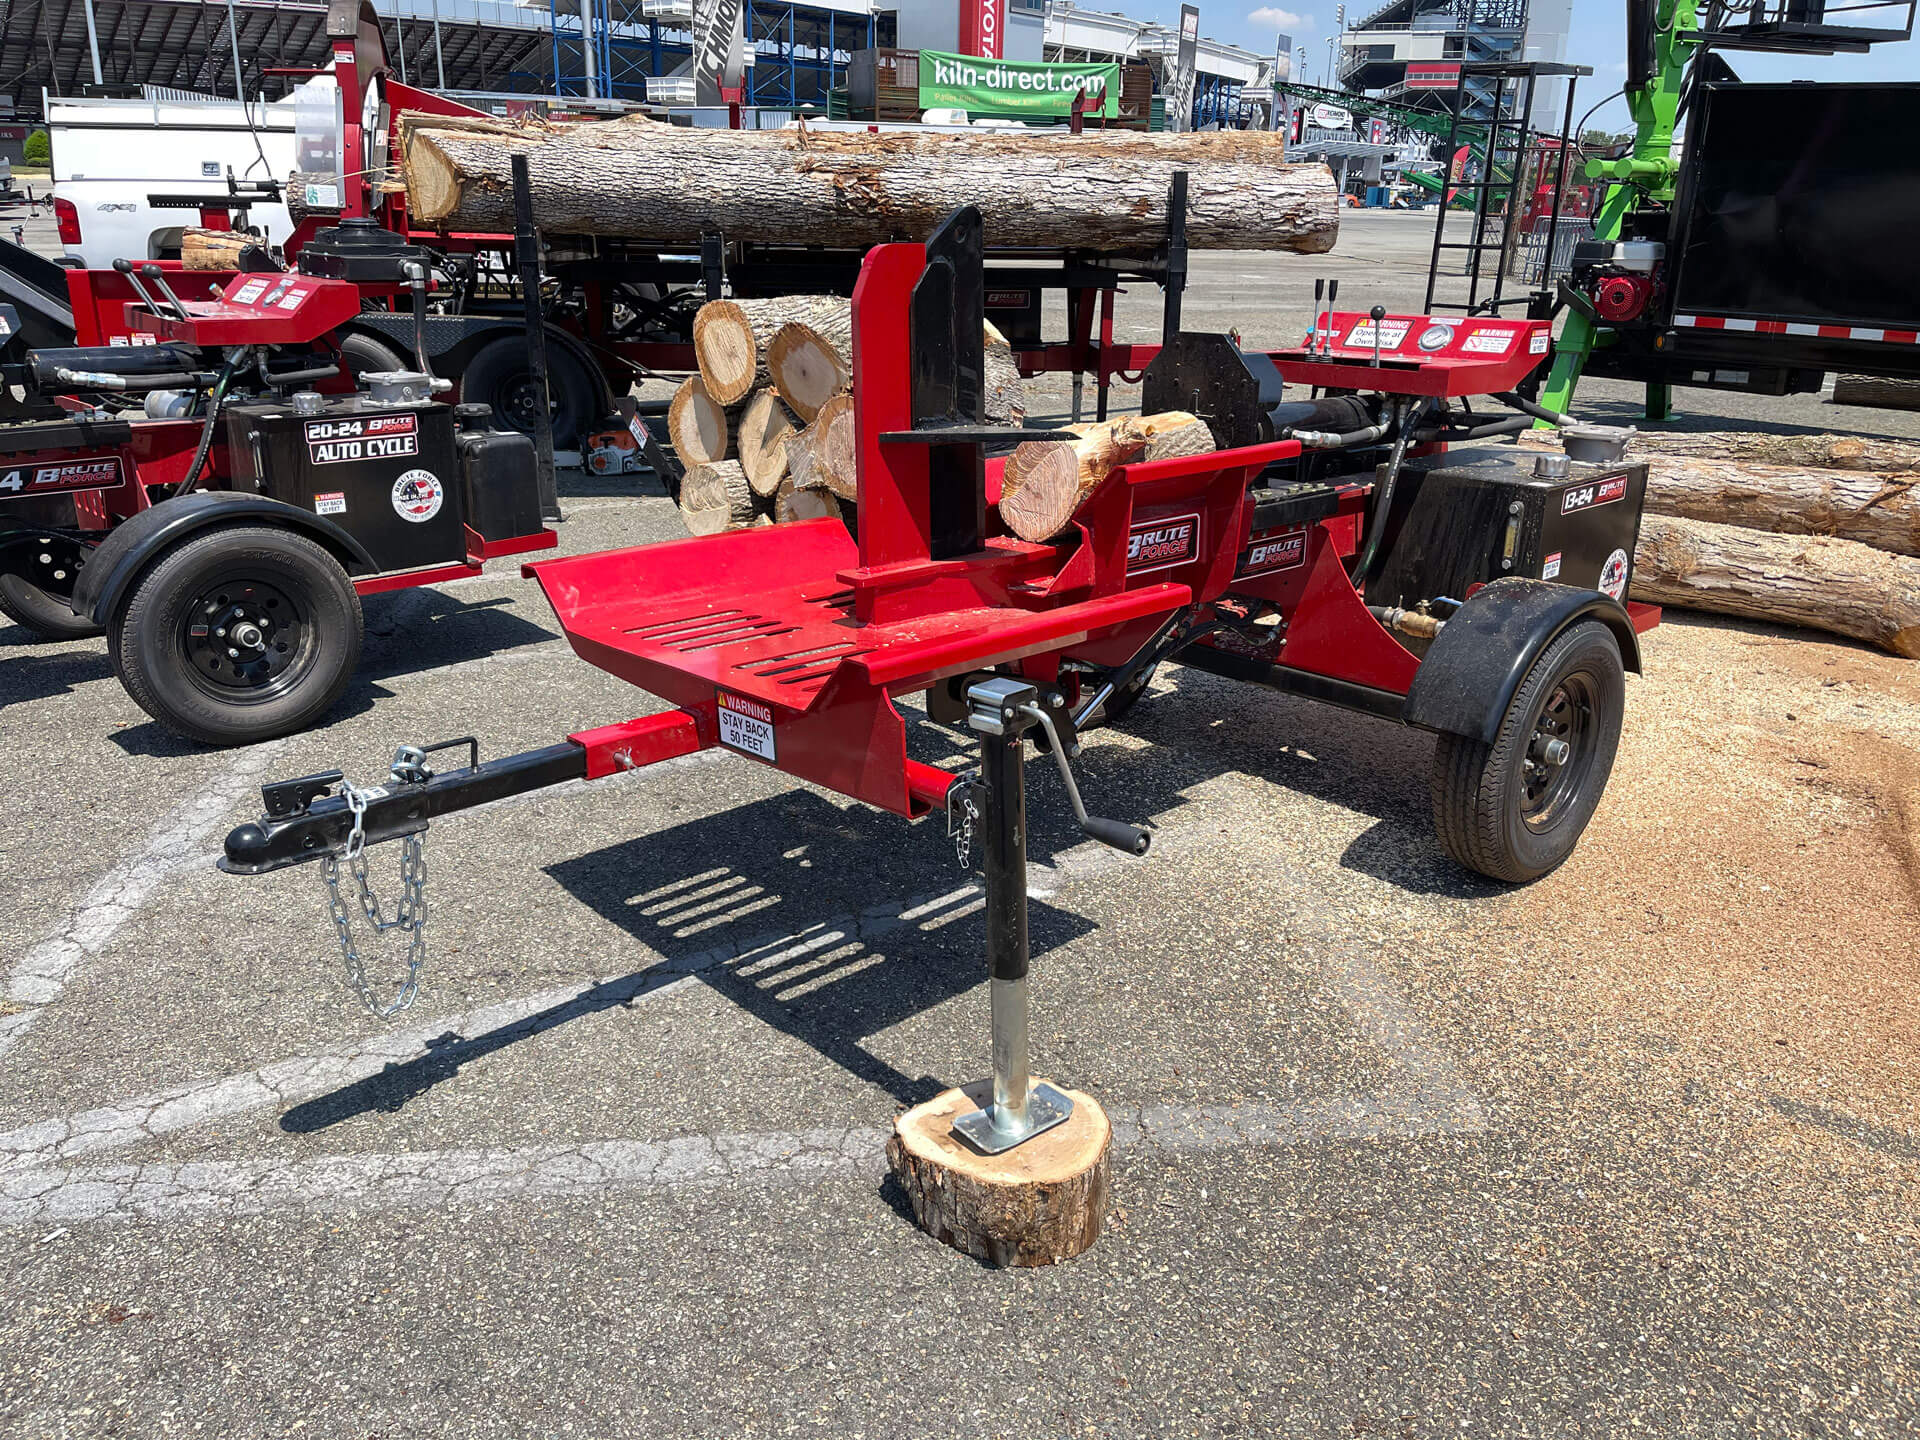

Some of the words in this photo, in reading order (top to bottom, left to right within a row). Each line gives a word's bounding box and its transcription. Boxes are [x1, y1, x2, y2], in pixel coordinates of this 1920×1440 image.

[935, 60, 1106, 93] kiln-direct.com
[1354, 337, 1373, 345] Own
[308, 421, 363, 439] 20-24
[369, 417, 414, 431] BRUTE
[315, 441, 362, 462] AUTO
[367, 437, 414, 456] CYCLE
[35, 462, 116, 483] BRUTE
[60, 471, 116, 483] FORCE
[1127, 525, 1191, 558] BRUTE
[1139, 538, 1189, 560] FORCE
[1249, 538, 1303, 565] BRUTE
[1265, 550, 1300, 565] FORCE
[726, 694, 772, 723] WARNING
[722, 712, 744, 730] STAY
[745, 720, 770, 741] BACK
[730, 729, 740, 744] 50
[742, 733, 763, 753] FEET
